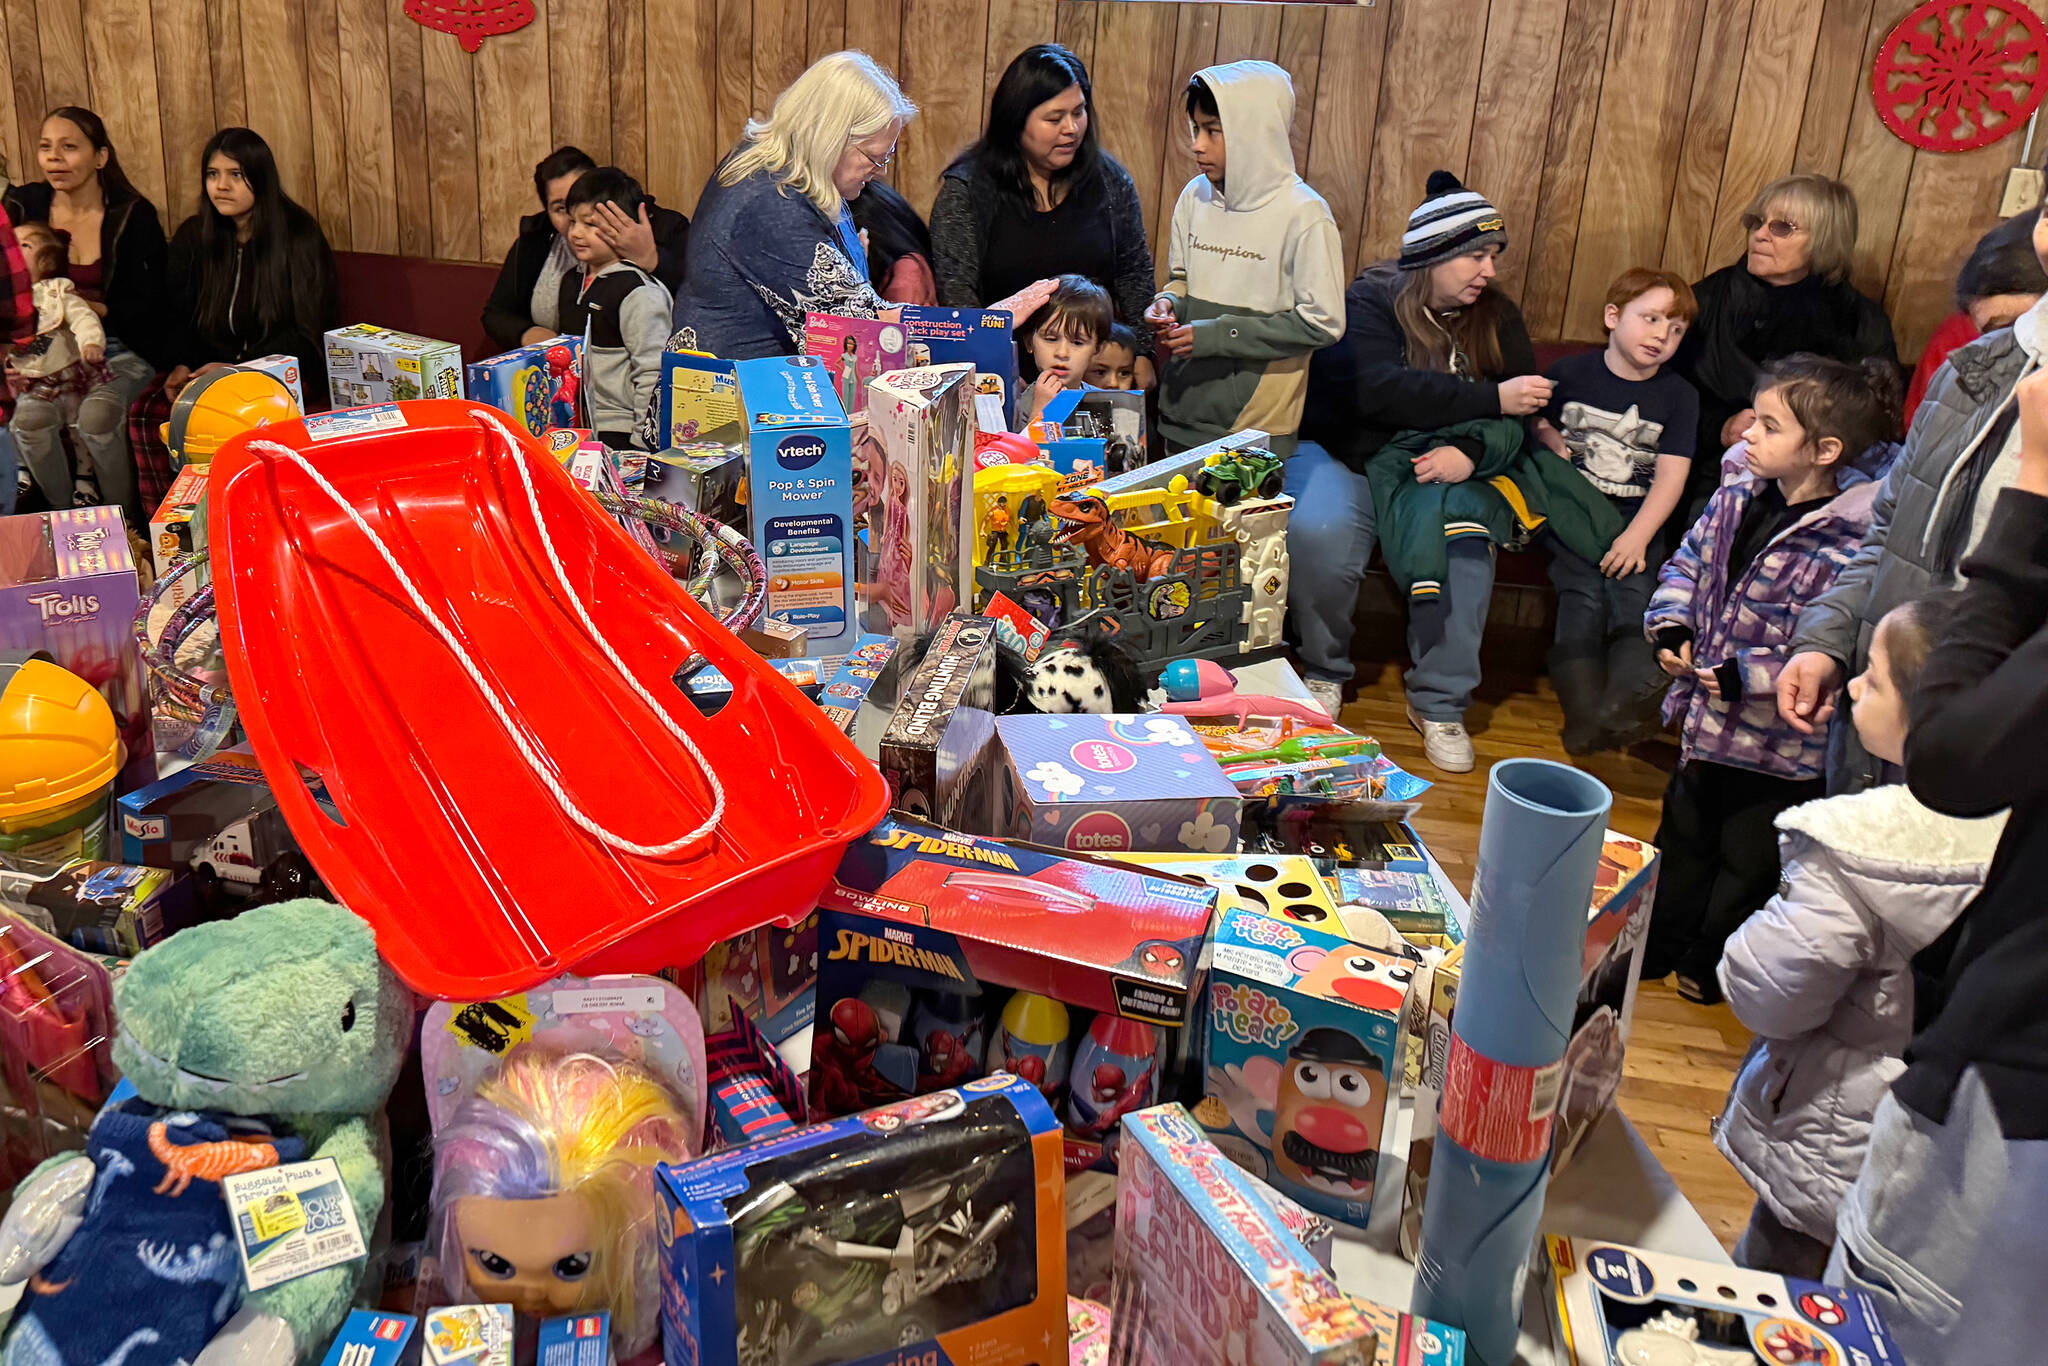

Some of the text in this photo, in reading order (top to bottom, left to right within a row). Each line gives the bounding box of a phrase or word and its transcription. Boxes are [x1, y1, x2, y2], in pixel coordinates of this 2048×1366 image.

[1188, 232, 1266, 262] Champion
[809, 316, 829, 328] Barbie
[904, 320, 962, 329] construction
[981, 320, 1005, 329] FUN!
[930, 328, 949, 338] play
[952, 329, 966, 337] set
[778, 444, 822, 458] vtech
[769, 478, 835, 491] Pop & Spin
[782, 491, 823, 501] Mower
[774, 518, 833, 528] Developmental
[787, 527, 820, 536] Benefits
[27, 594, 100, 620] Trolls
[906, 655, 962, 735] HUNTING BLIND
[1091, 744, 1113, 769] totes
[942, 832, 976, 847] MARVEL
[1075, 833, 1123, 848] totes
[870, 829, 1019, 872] SPIDER-MAN
[834, 888, 911, 912] BOWLING
[852, 900, 886, 912] SET
[884, 927, 914, 945] MARVEL
[1238, 915, 1299, 940] Potato
[1238, 926, 1293, 949] Head
[827, 929, 966, 983] SPIDER-MAN
[1121, 995, 1181, 1016] OUTDOOR FUN!
[1134, 988, 1174, 1006] INDOOR &
[1211, 984, 1290, 1025] Potato
[1215, 1009, 1284, 1046] Head
[303, 1198, 338, 1216] YOUR
[306, 1210, 345, 1233] ZONE
[1127, 1142, 1258, 1328] CANDY
[1123, 1190, 1222, 1340] LAND
